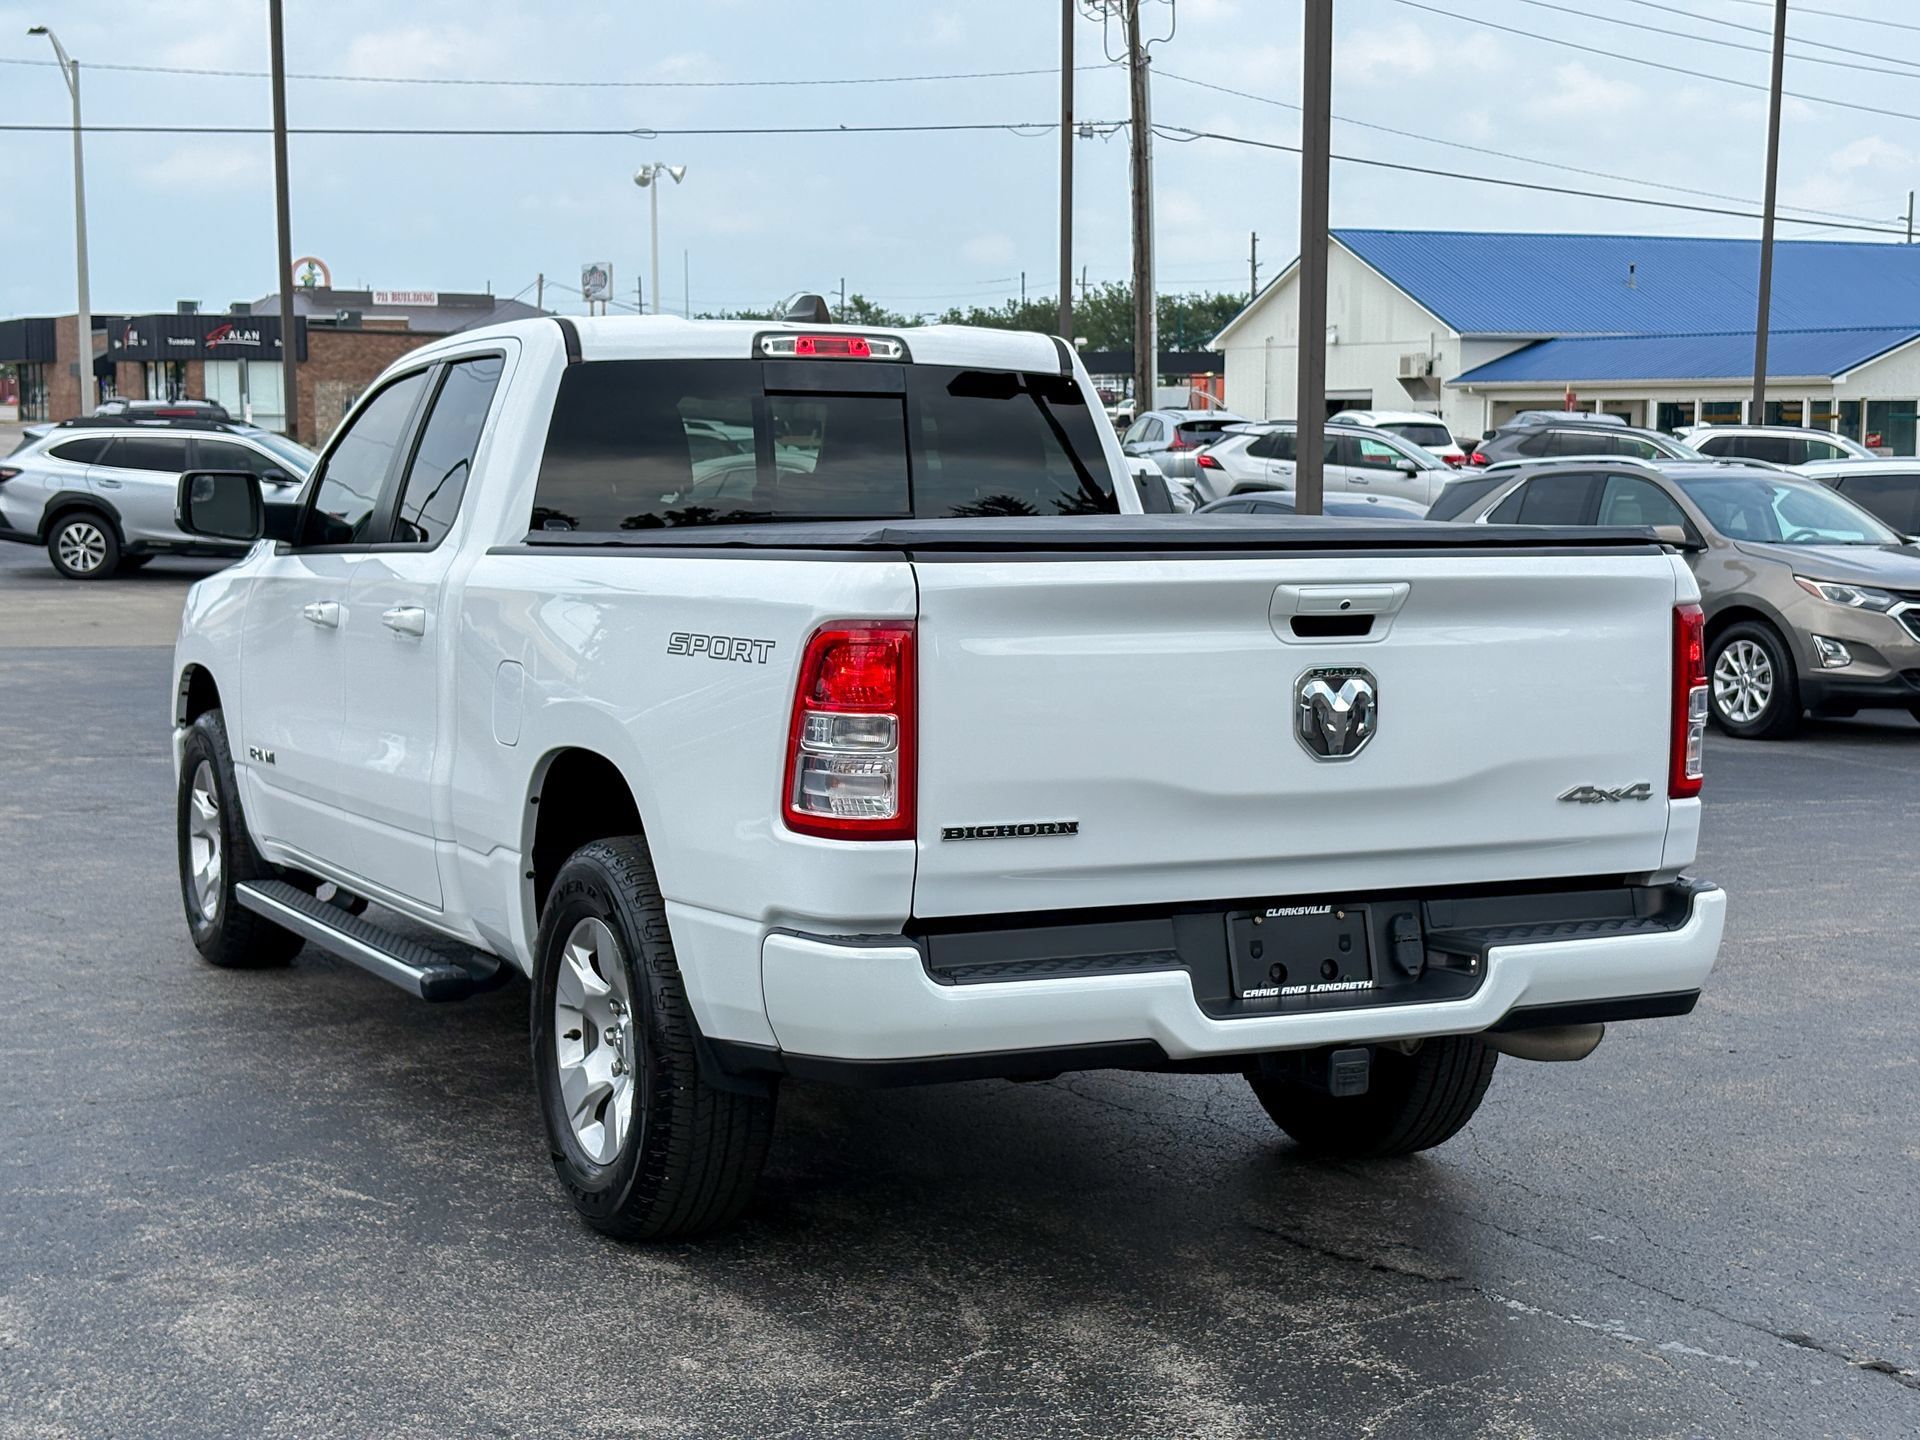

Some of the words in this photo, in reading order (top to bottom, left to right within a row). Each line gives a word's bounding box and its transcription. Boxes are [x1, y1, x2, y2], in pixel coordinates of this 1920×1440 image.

[391, 291, 435, 303] BUILDING
[228, 330, 260, 341] ALAN
[667, 632, 776, 664] SPORT
[942, 821, 1079, 840] BIGHORN
[1266, 905, 1332, 917] CLARKSVILLE
[1242, 987, 1279, 998] CRAIG
[1281, 984, 1307, 995] AND
[1310, 980, 1373, 993] LANDRETH
